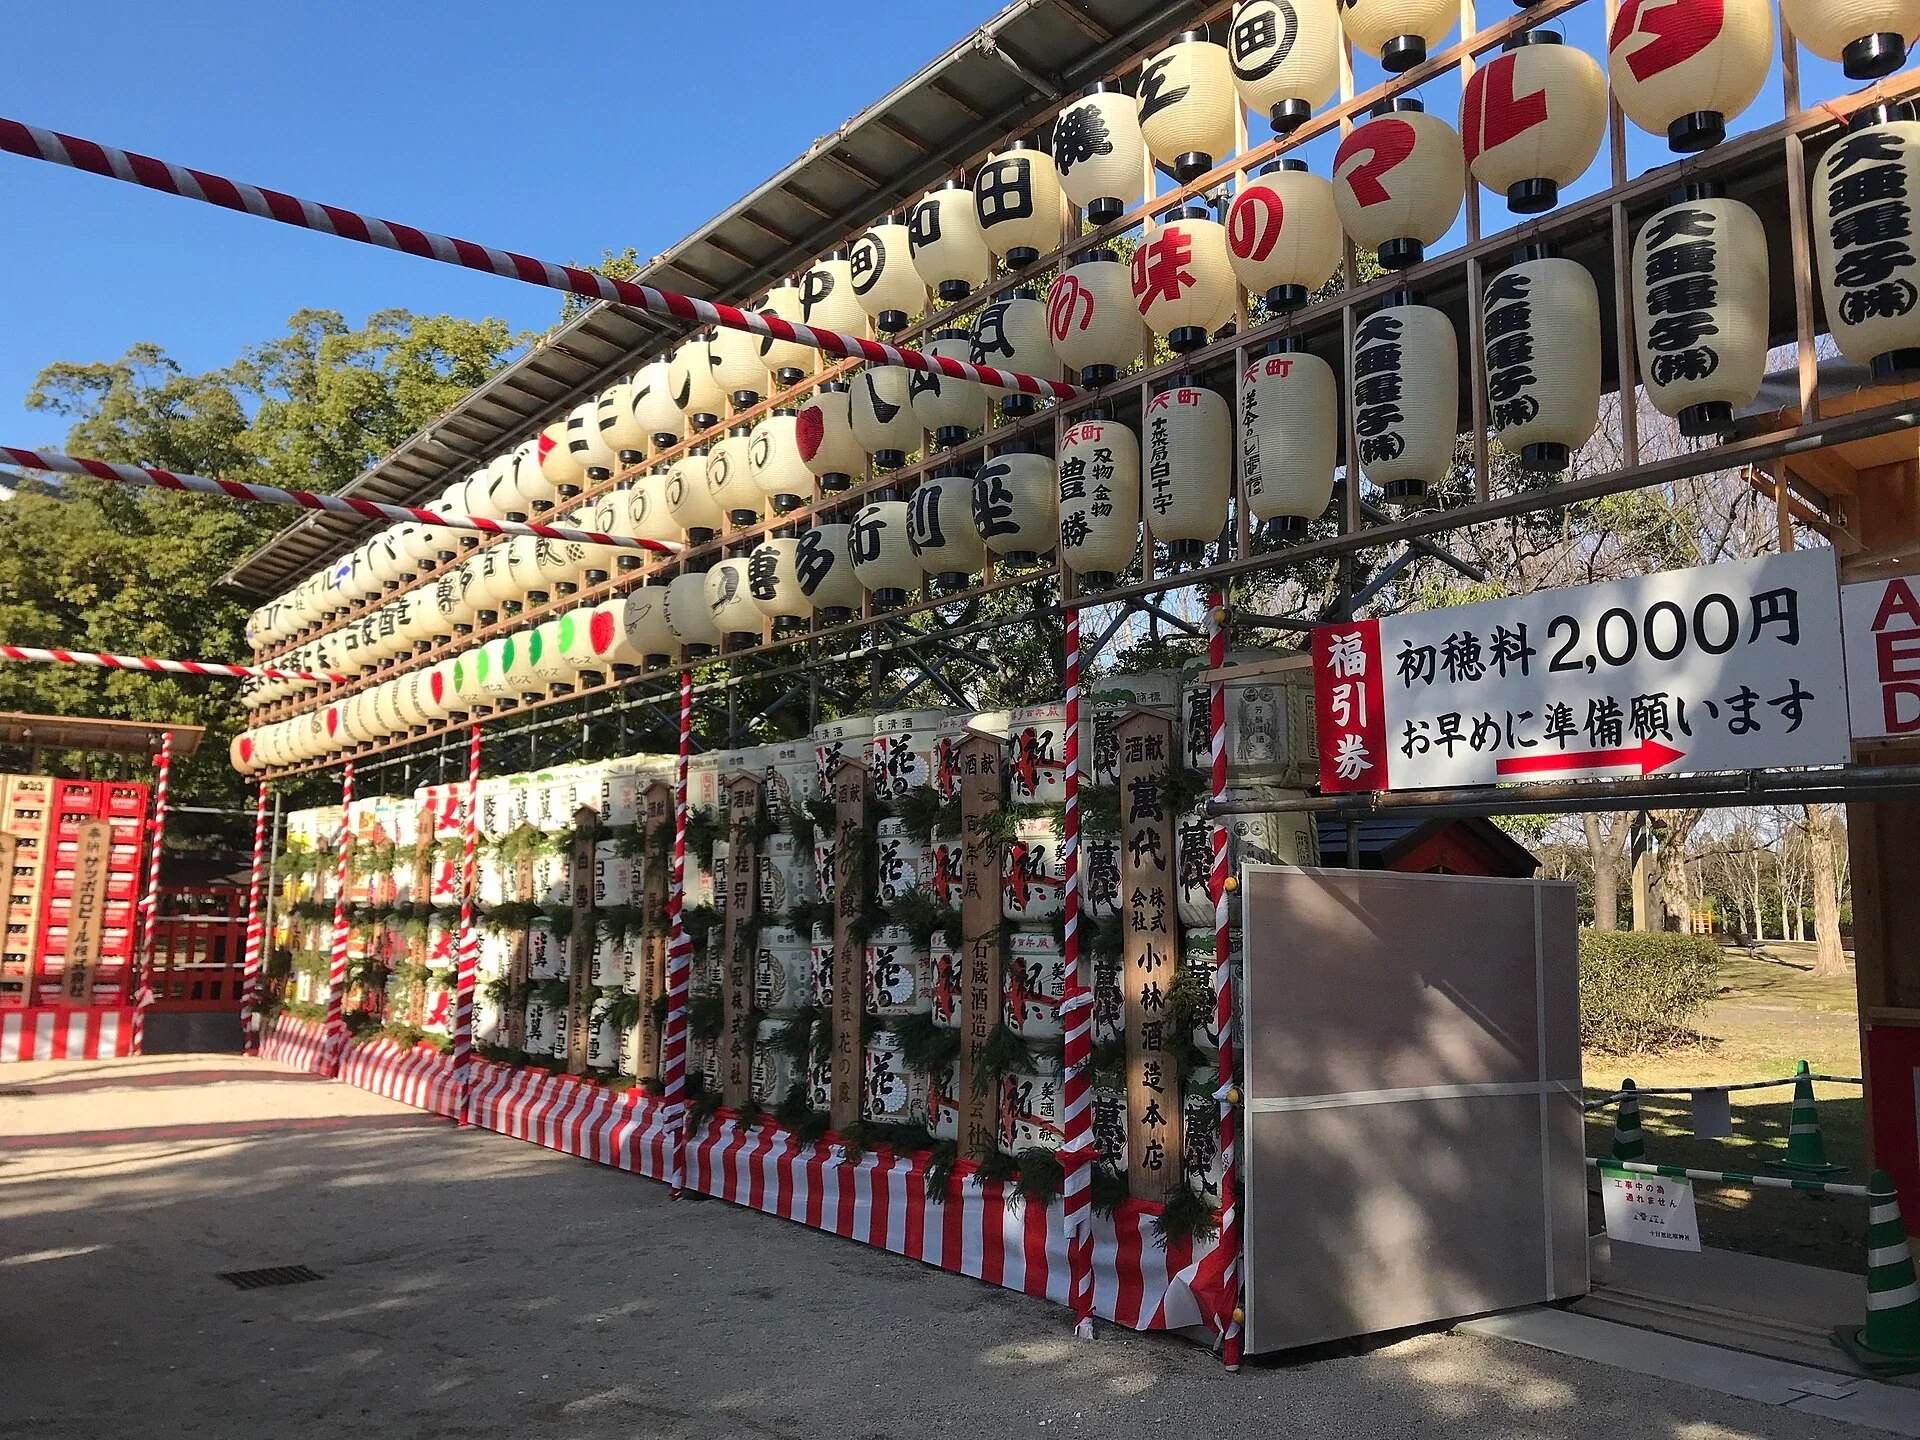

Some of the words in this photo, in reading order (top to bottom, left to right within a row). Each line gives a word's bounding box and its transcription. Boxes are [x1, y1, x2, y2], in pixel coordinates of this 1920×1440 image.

[1462, 53, 1549, 166] ル
[974, 157, 1034, 229] 田
[1333, 118, 1416, 207] マ
[1226, 186, 1284, 262] の
[1131, 226, 1197, 316] 味
[1871, 578, 1920, 734] AED
[1327, 631, 1375, 781] 福引券
[1400, 678, 1816, 760] お早めに準備願います
[1127, 775, 1167, 872] 萬代
[1138, 943, 1168, 1172] 小林酒造本店
[1614, 1179, 1665, 1195] 工事中の為
